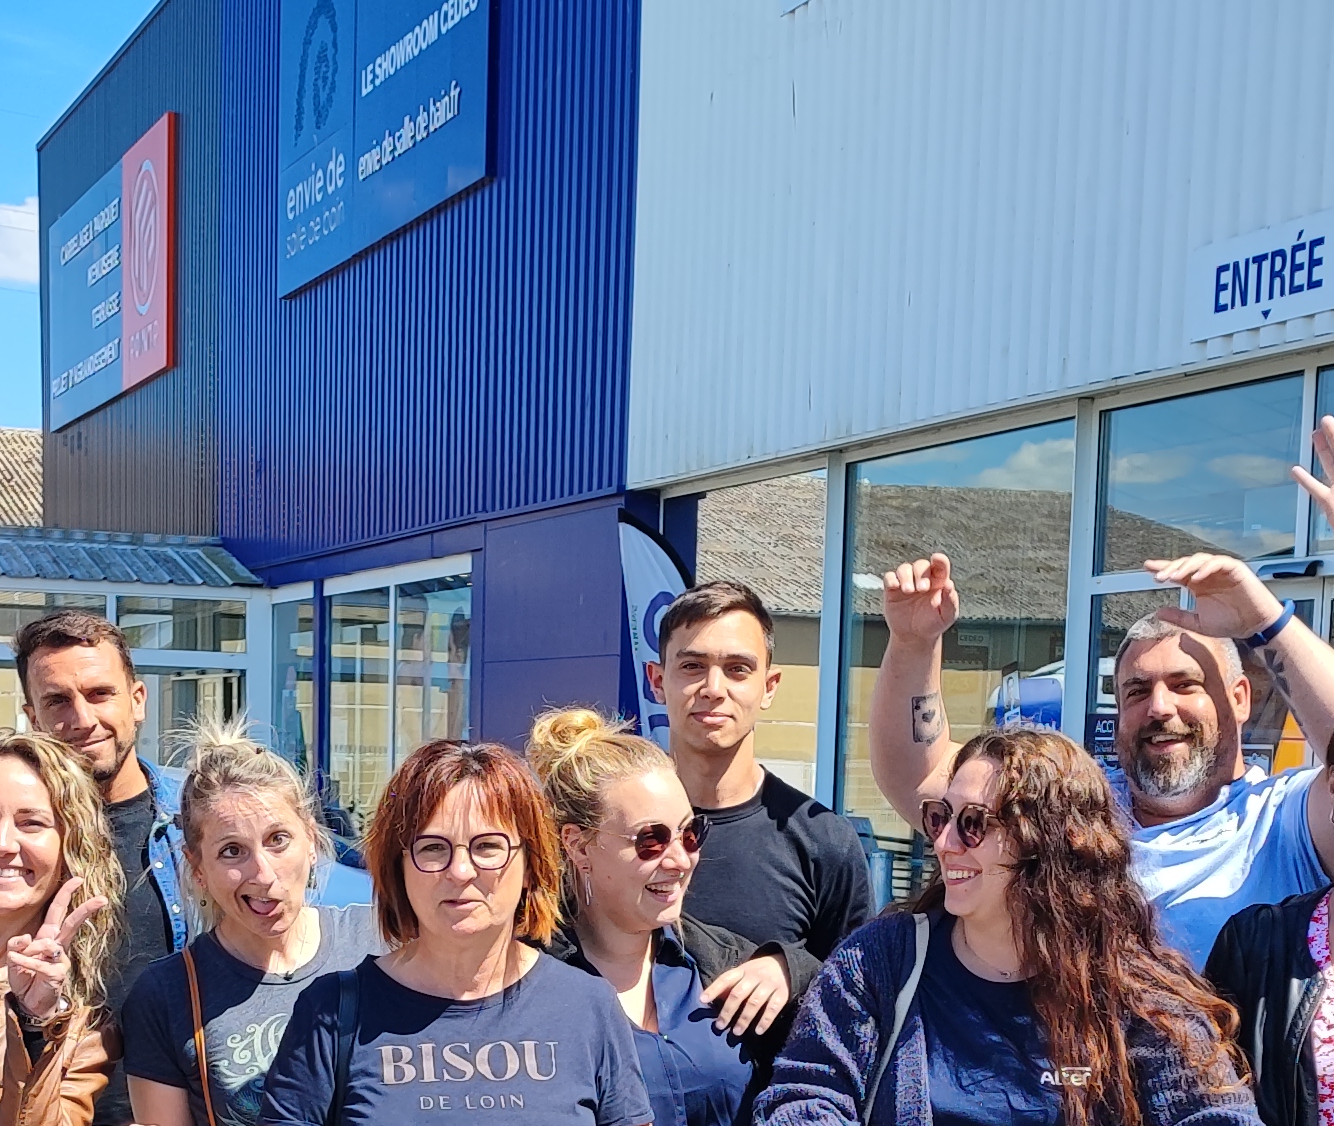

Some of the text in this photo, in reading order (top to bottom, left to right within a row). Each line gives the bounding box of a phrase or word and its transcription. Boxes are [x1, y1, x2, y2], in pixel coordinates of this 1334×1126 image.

[361, 63, 374, 97] LE
[374, 10, 439, 87] SHOWROOM
[358, 139, 381, 182] envie
[381, 130, 394, 166] de
[394, 114, 415, 157] salle
[415, 104, 429, 142] de
[286, 146, 346, 220] envie de
[1213, 229, 1326, 314] ENTRÉE
[377, 1040, 559, 1086] BISOU
[419, 1094, 525, 1110] DE LOIN
